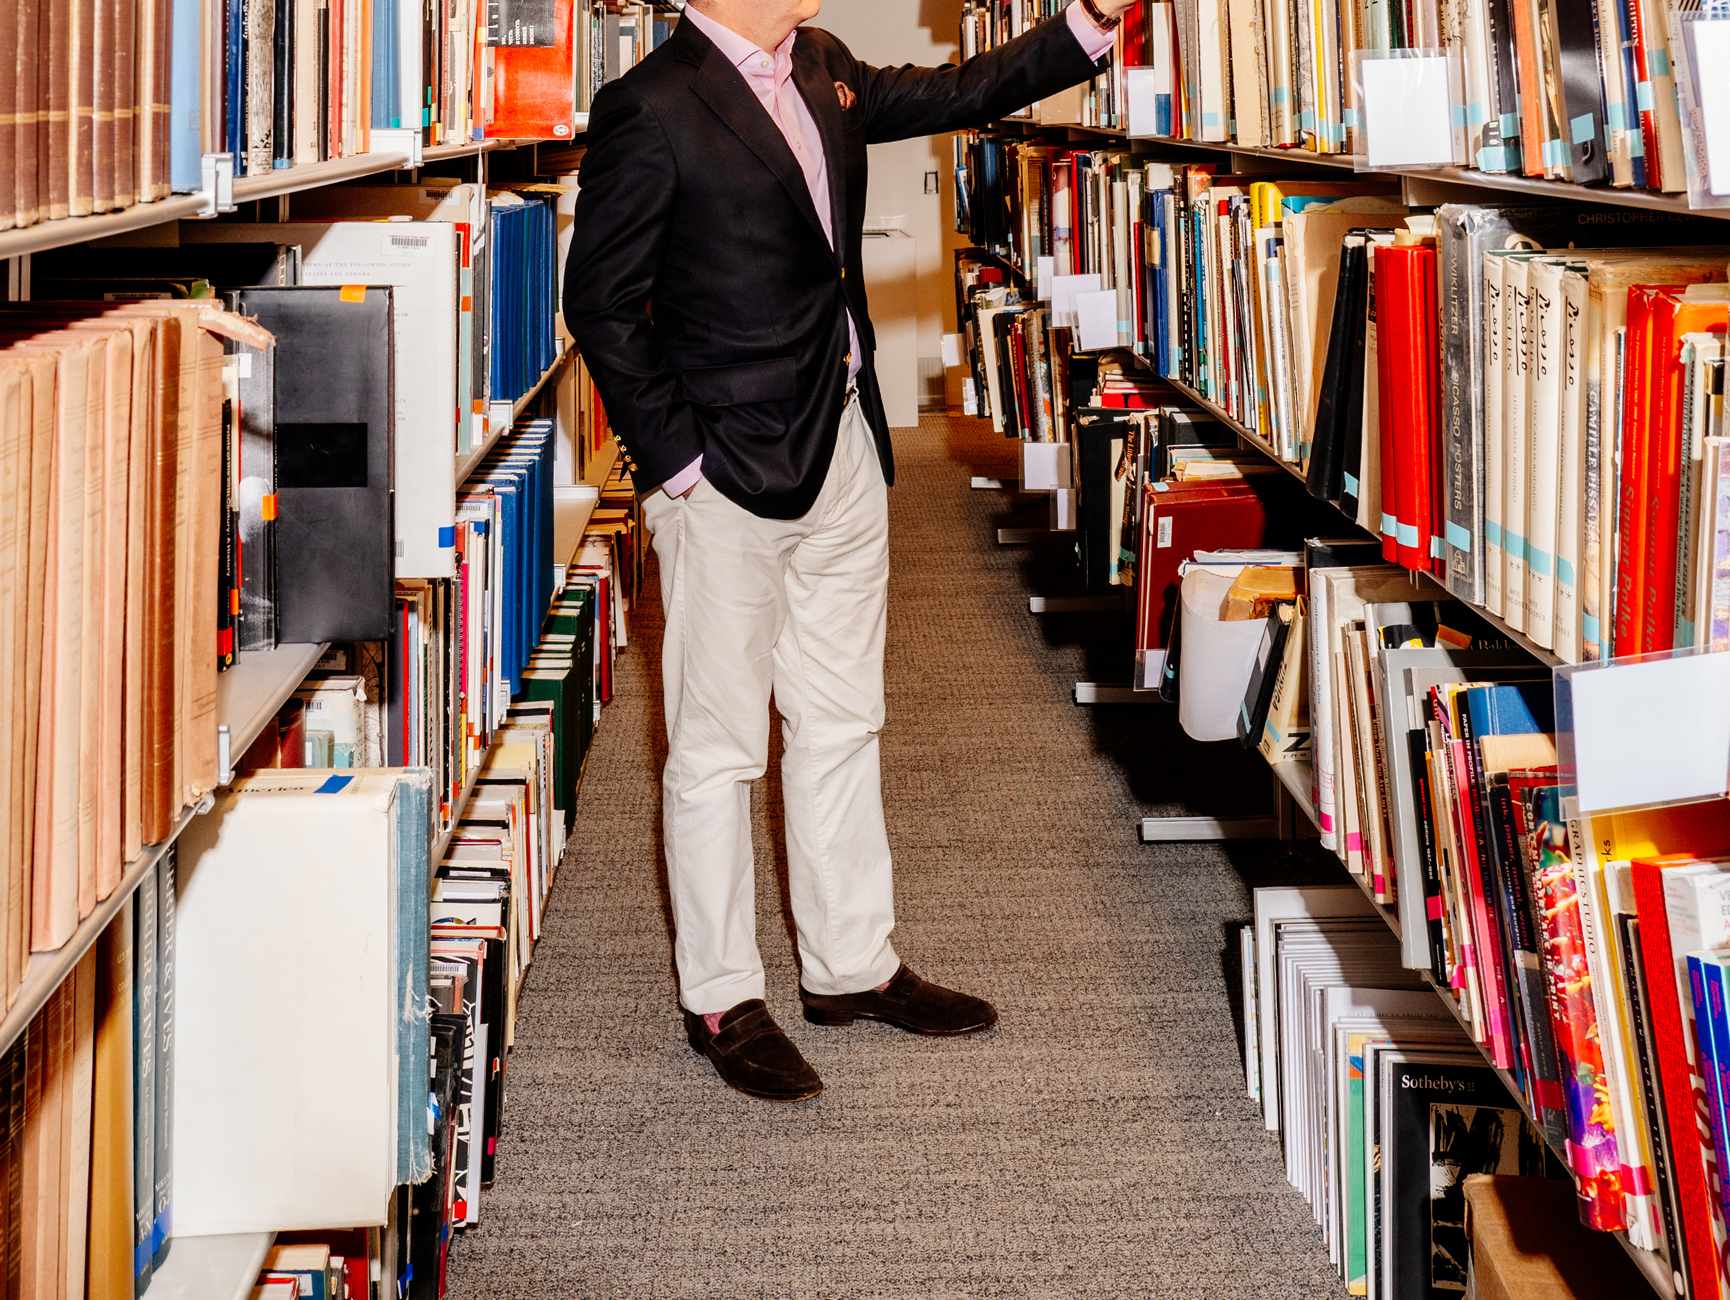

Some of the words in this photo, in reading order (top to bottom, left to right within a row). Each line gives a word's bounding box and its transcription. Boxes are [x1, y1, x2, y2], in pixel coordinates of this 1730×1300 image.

[1601, 8, 1611, 60] Lehmbruck
[1578, 212, 1664, 225] CHRISTOPHER
[1451, 238, 1459, 334] CZWIKLITZER
[1491, 285, 1500, 361] Picasso
[1518, 292, 1530, 370] Picasso
[1539, 295, 1550, 375] Picasso
[1569, 301, 1580, 385] Picasso
[1453, 372, 1461, 436] PICASSO
[1588, 390, 1597, 470] CAMILLE
[1454, 442, 1462, 510] POSTERS
[1588, 472, 1597, 554] PISSARRO
[1622, 482, 1634, 568] Sigmar
[1647, 492, 1660, 578] Sigmar
[1683, 496, 1691, 562] MEXICAN
[1677, 574, 1682, 585] of
[1681, 566, 1689, 616] PRINTS
[1621, 572, 1633, 638] Polke
[1645, 584, 1657, 651] Polke
[1462, 714, 1470, 738] PAPER
[1465, 740, 1471, 748] IN
[1466, 750, 1476, 786] PROFILE:
[1379, 794, 1387, 818] Lucky
[1500, 796, 1509, 820] ink,
[1504, 824, 1516, 860] paper,
[1526, 802, 1546, 916] CONTEMPORARY
[1505, 860, 1514, 894] Painters
[1511, 866, 1523, 906] metal,
[1570, 818, 1595, 954] GRAPHICSTUDIO
[144, 871, 154, 979] URRIER
[1487, 906, 1493, 918] DE
[1512, 911, 1522, 948] Sculptors
[1518, 910, 1530, 946] wood
[1541, 920, 1550, 946] ART
[164, 962, 173, 984] &
[1521, 968, 1529, 993] Crown
[1545, 950, 1553, 969] IN
[144, 985, 152, 1007] &
[1494, 966, 1506, 1017] MEXICANA
[1525, 996, 1533, 1017] Point
[1548, 974, 1560, 1020] PRINT
[142, 1011, 152, 1078] IVES
[162, 990, 172, 1052] IVES
[1528, 1018, 1536, 1042] Press
[1401, 1074, 1465, 1094] Sotheby's
[1708, 1059, 1724, 1146] CONVERSATIONS
[1642, 1054, 1656, 1112] FORTY
[1653, 1126, 1666, 1180] YEARS
[1718, 1148, 1727, 1178] FROM
[1722, 1182, 1730, 1204] THE
